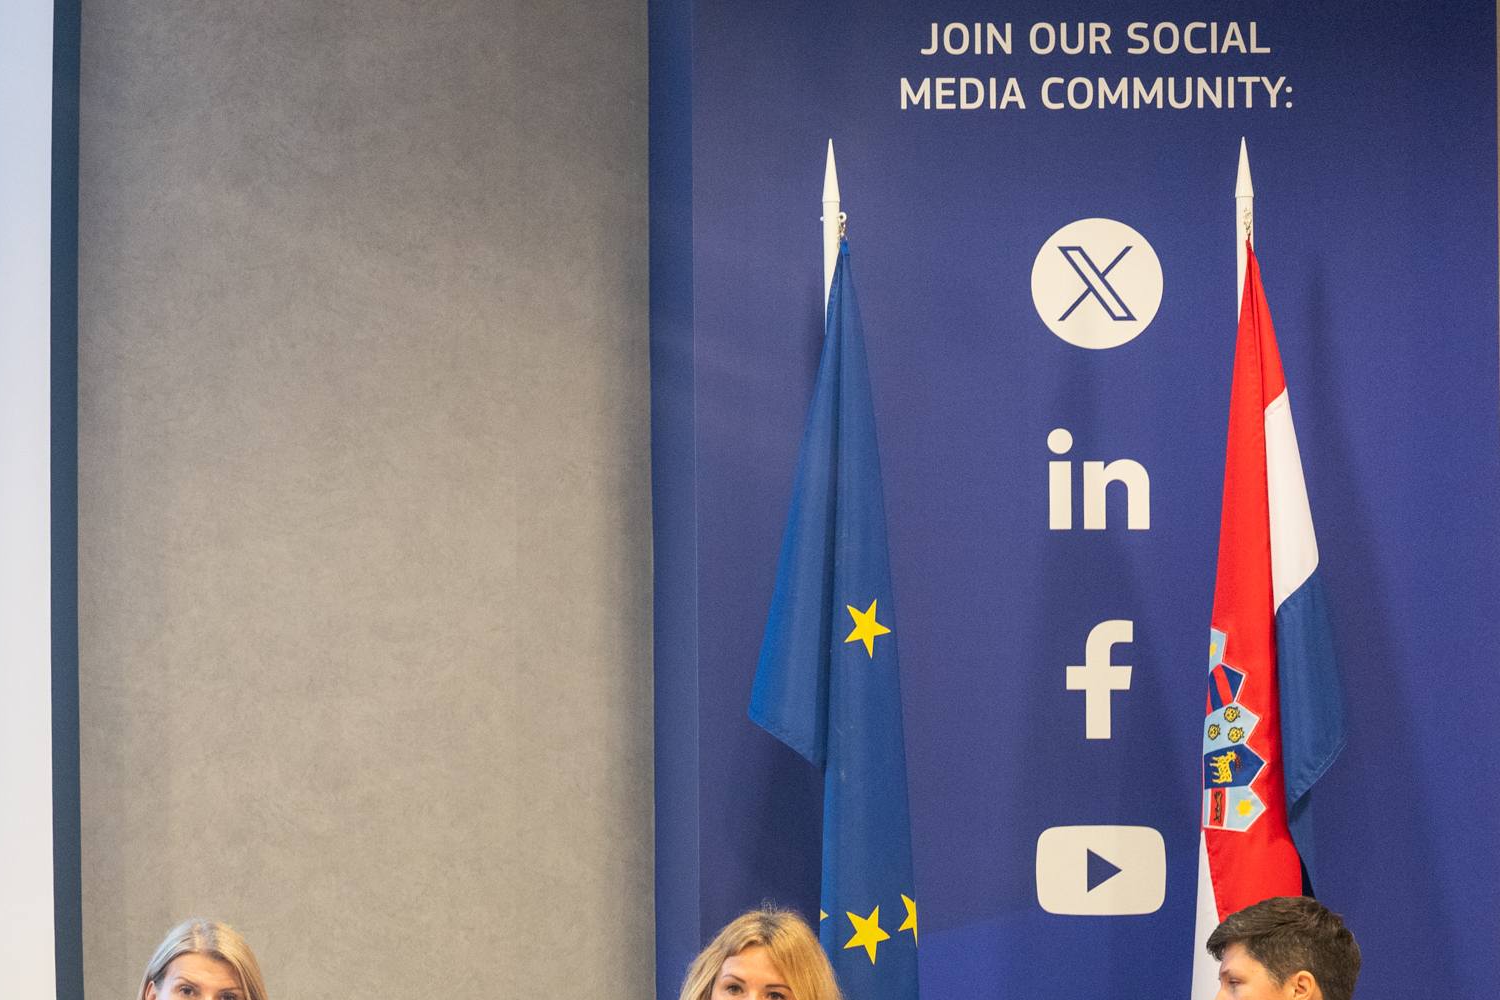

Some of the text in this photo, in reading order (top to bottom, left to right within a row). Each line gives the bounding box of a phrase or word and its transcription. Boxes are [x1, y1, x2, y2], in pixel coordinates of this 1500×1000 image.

[921, 21, 1271, 55] JOIN OUR SOCIAL
[900, 76, 1293, 109] MEDIA COMMUNITY:
[1047, 428, 1150, 530] in
[1066, 619, 1133, 739] f
